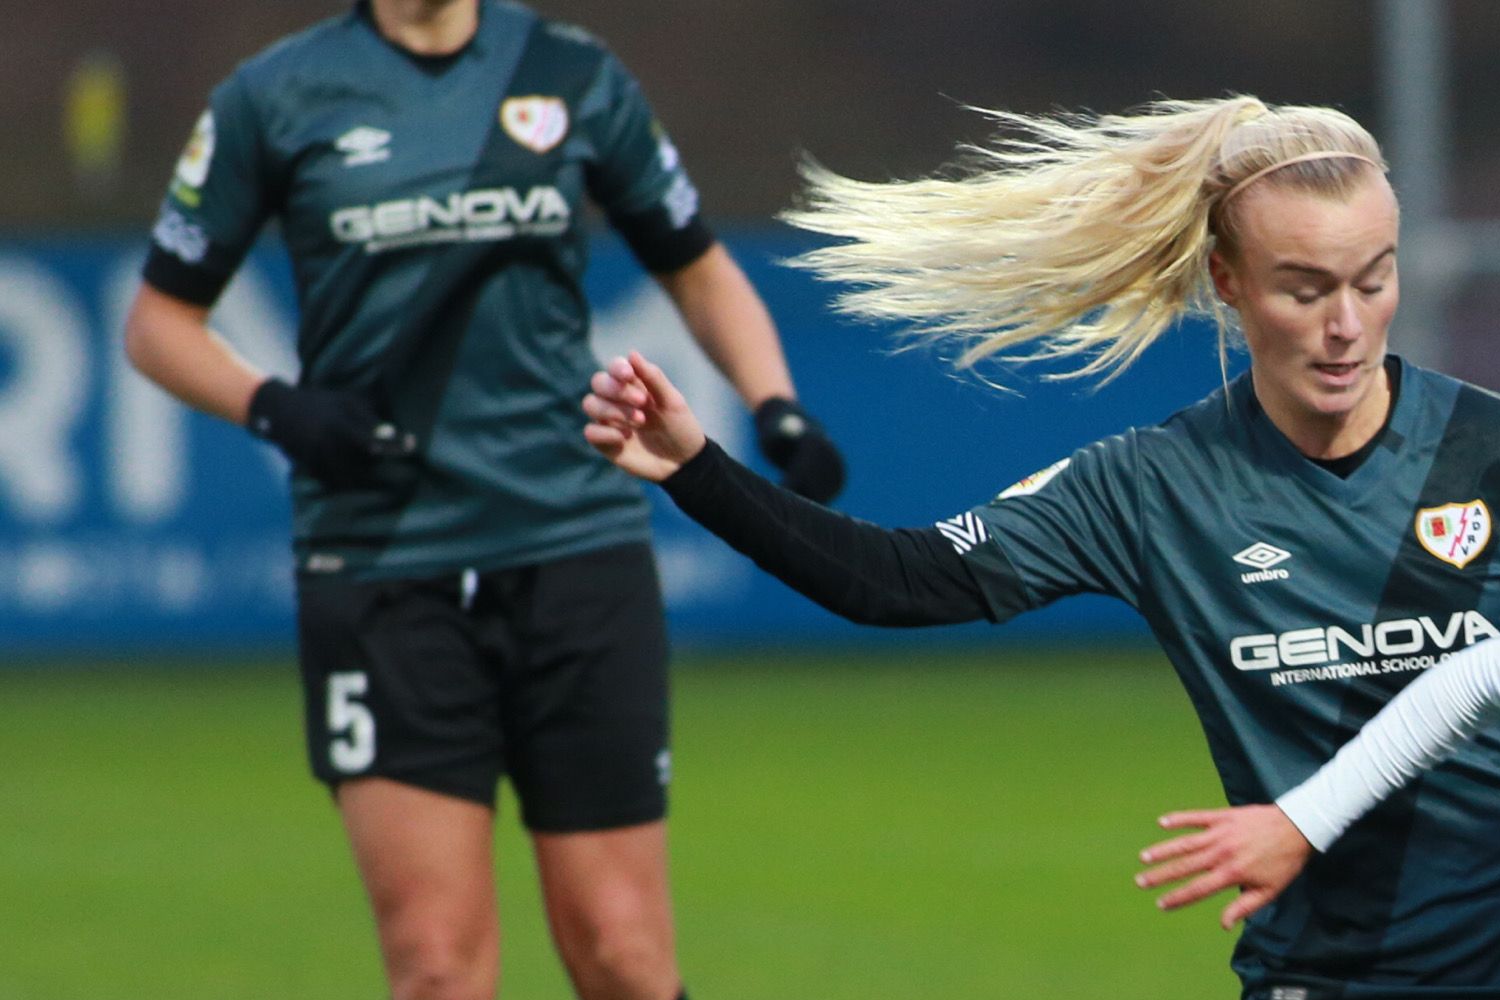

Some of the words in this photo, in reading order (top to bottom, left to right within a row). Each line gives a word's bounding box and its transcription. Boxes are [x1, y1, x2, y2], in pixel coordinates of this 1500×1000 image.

[330, 186, 570, 243] GENOVA
[1241, 568, 1289, 584] umbro
[1271, 660, 1382, 687] INTERNATIONAL
[1382, 653, 1437, 676] SCHOOL
[328, 672, 377, 774] 5
